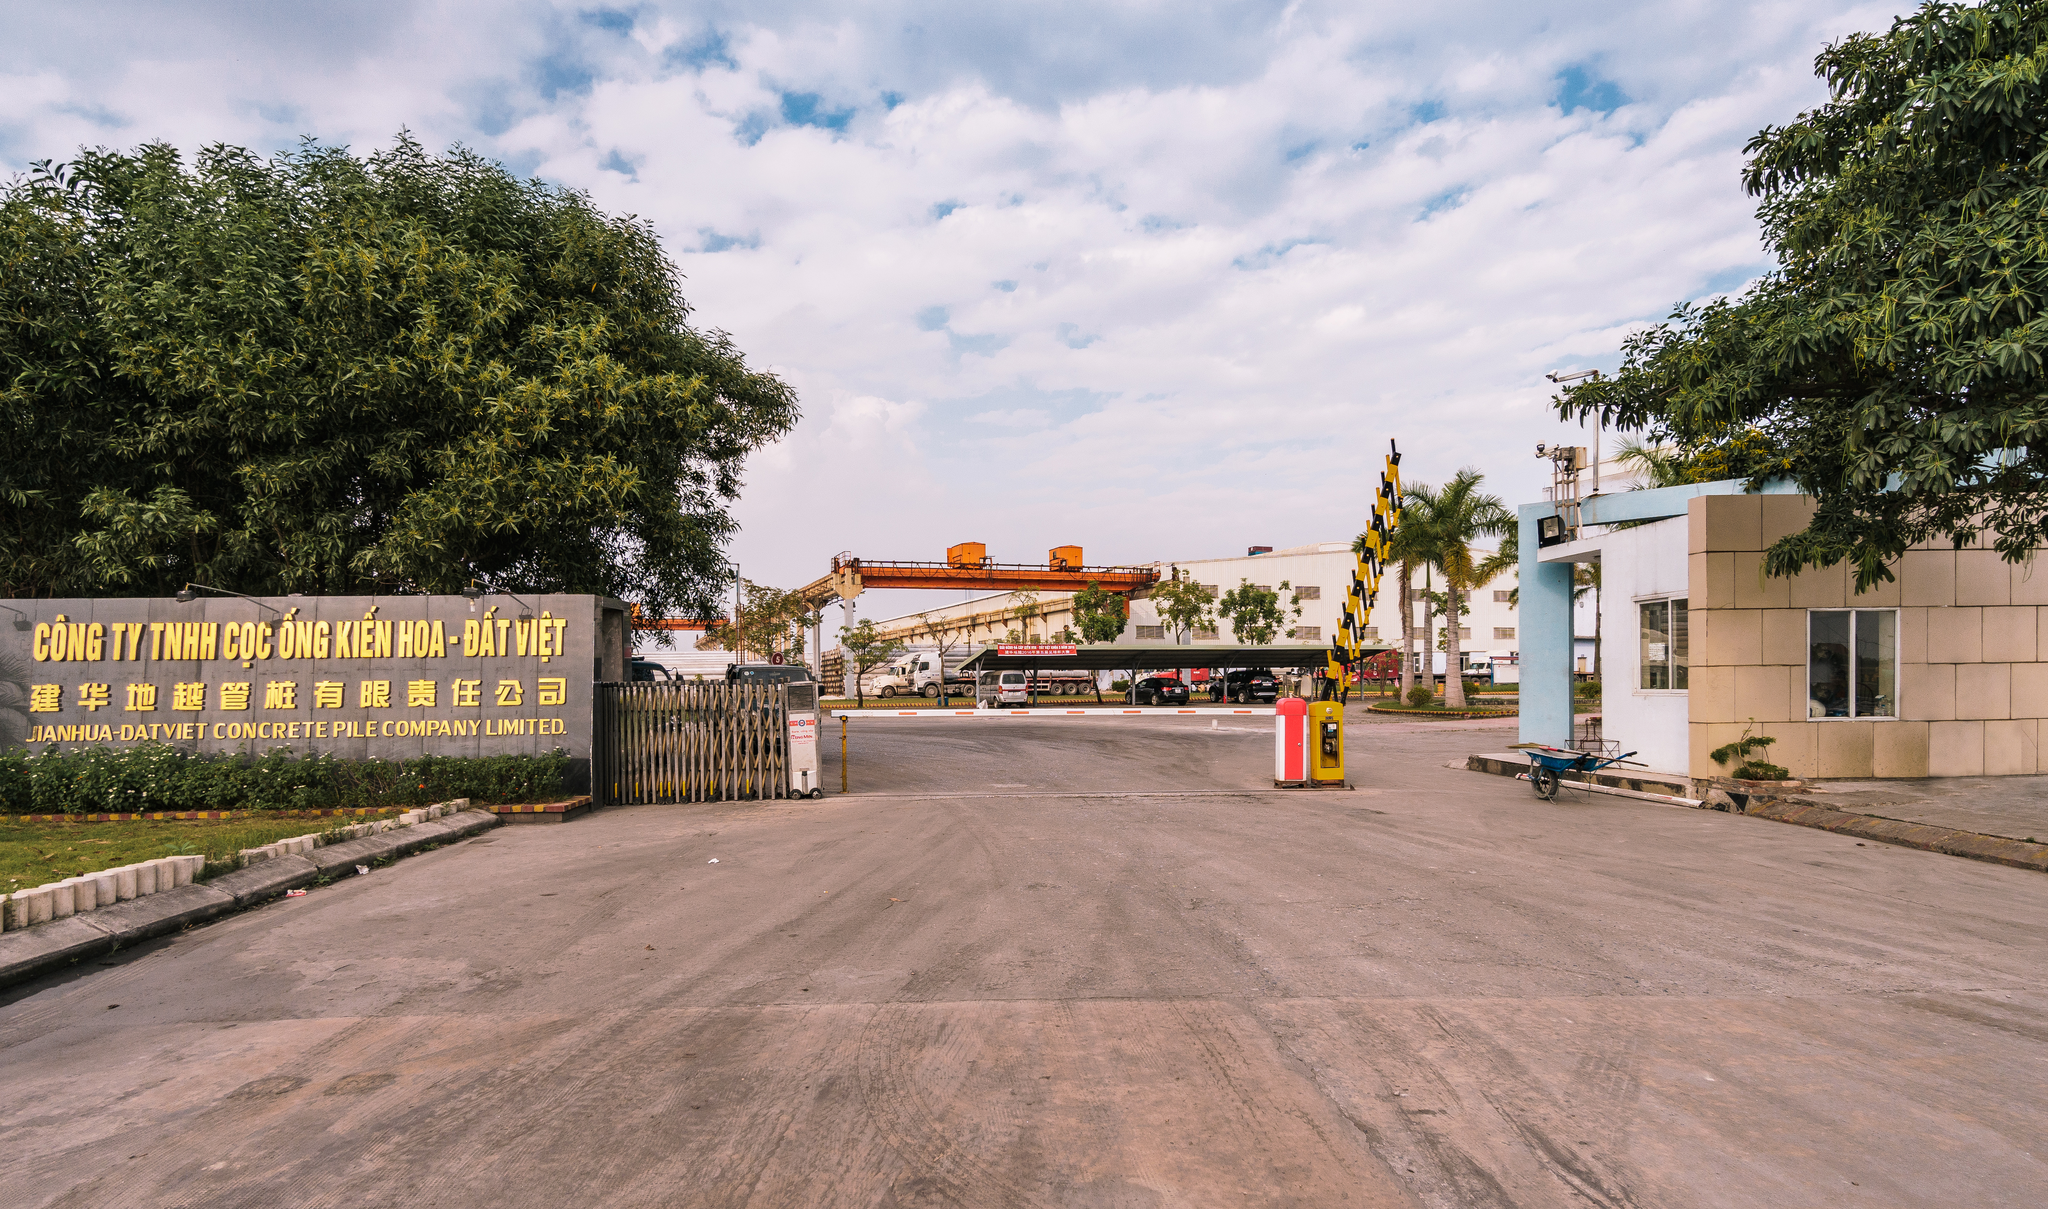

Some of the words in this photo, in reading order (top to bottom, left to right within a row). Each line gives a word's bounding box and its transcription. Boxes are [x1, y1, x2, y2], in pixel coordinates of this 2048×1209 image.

[33, 614, 104, 662] CÔNG
[112, 622, 143, 661] TY
[150, 622, 218, 660] TNHH
[223, 621, 273, 668] CỌC
[279, 607, 330, 659] ỐNG
[335, 605, 392, 658] KIẾN
[398, 619, 446, 658] HOA
[463, 605, 511, 657] ĐẤT
[515, 610, 567, 663] VIỆT
[775, 655, 781, 664] 5
[29, 677, 567, 713] 建华地越管桩有限责任公司
[212, 721, 329, 740] CONCRETE
[332, 720, 378, 738] PILE
[381, 718, 482, 738] COMPANY
[485, 717, 568, 737] LIMITED.
